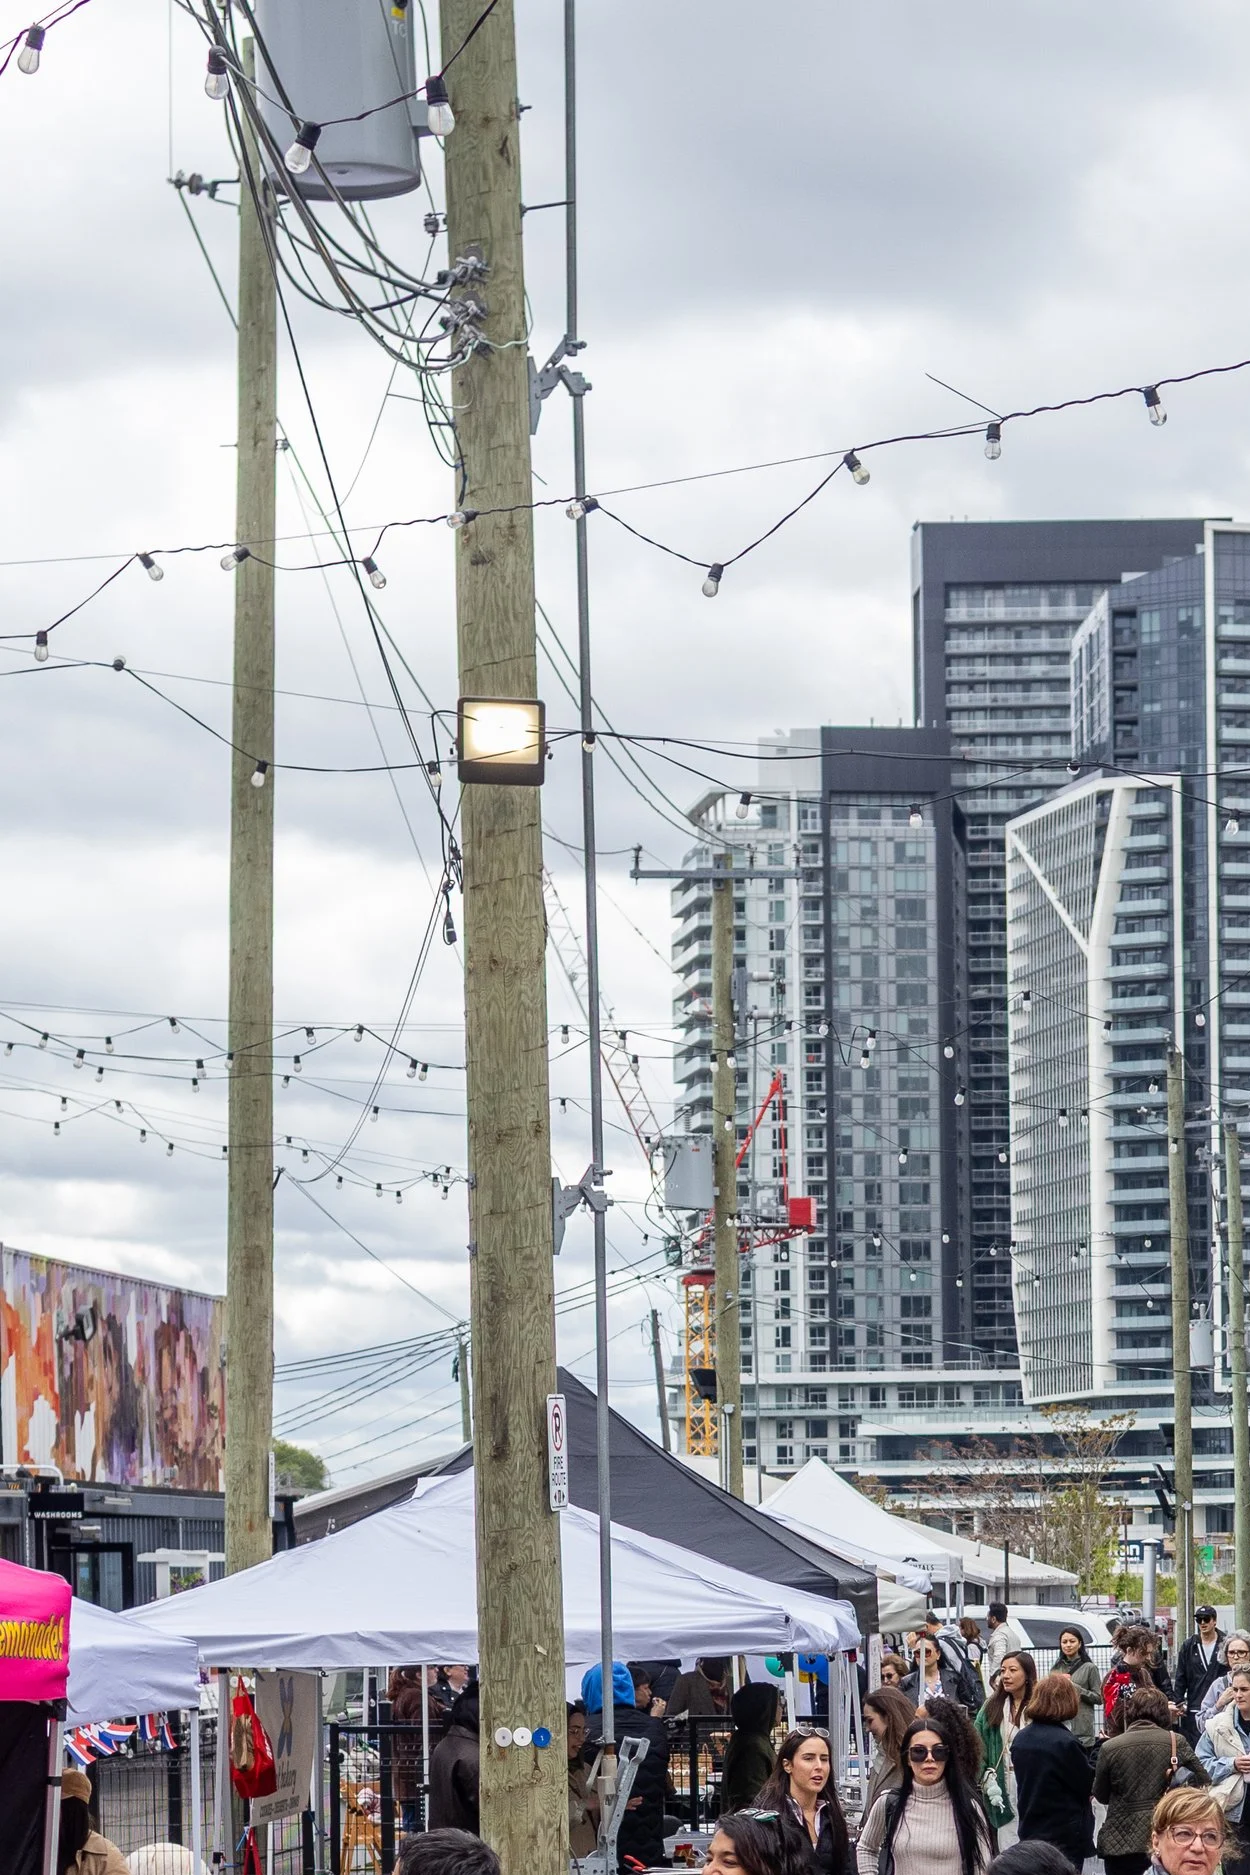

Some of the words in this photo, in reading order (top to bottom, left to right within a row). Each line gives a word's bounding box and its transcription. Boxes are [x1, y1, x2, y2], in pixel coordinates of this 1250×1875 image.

[553, 1456, 563, 1470] FIRE
[552, 1472, 566, 1486] ROUTE
[34, 1511, 83, 1519] WASHROOMS
[0, 1614, 65, 1661] emonade!
